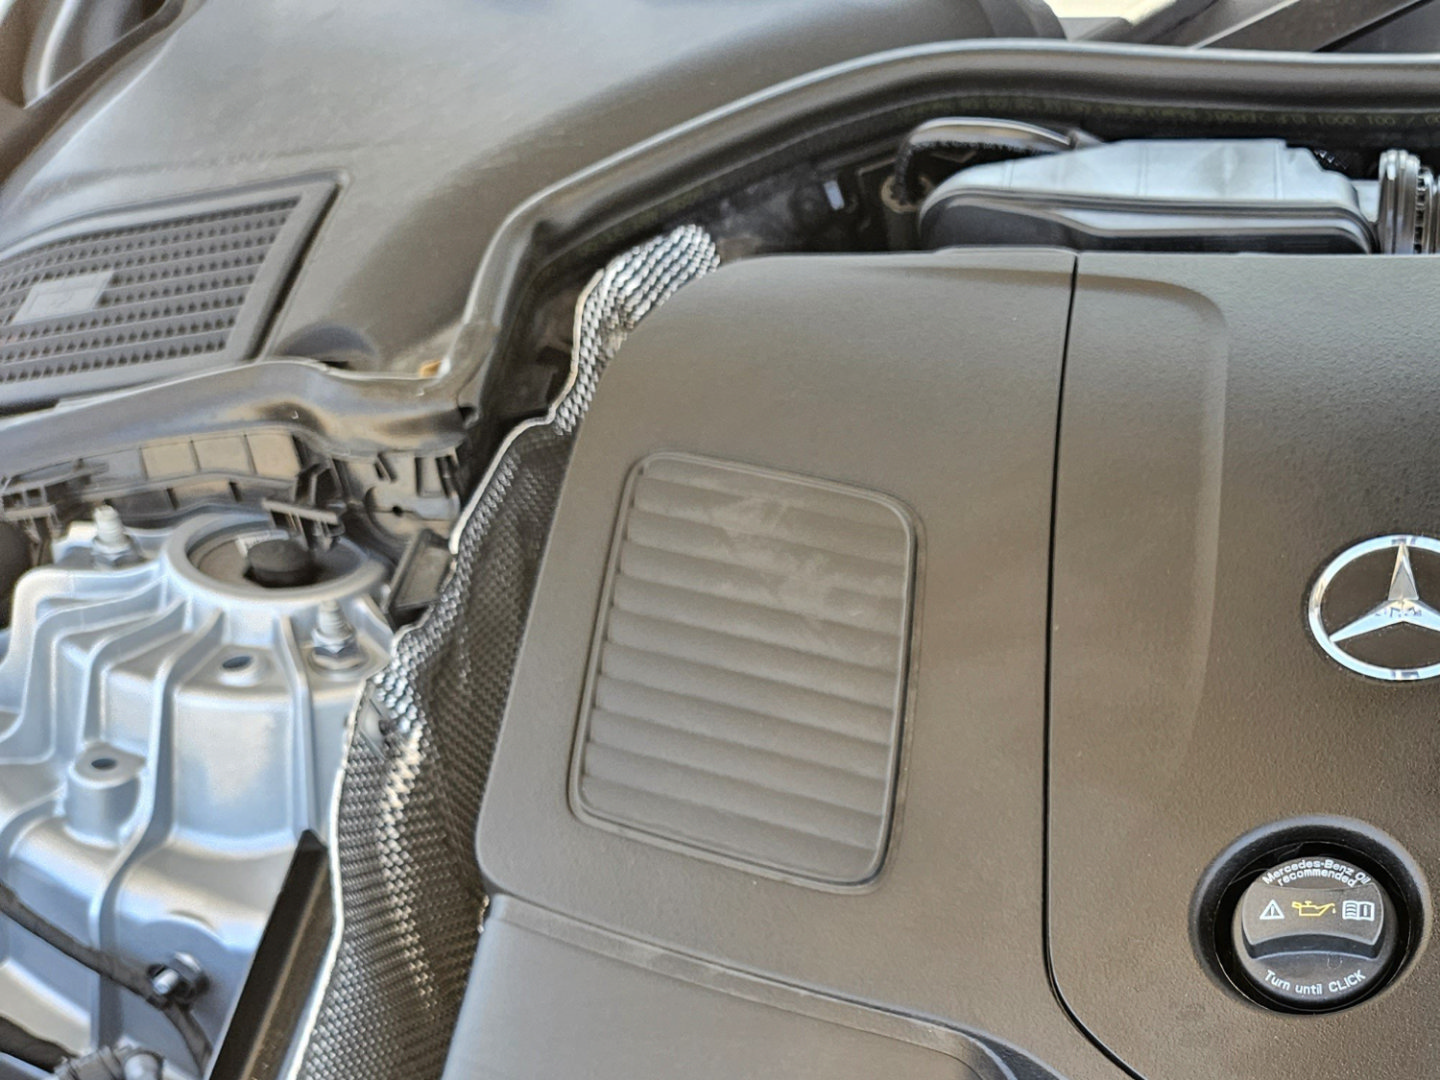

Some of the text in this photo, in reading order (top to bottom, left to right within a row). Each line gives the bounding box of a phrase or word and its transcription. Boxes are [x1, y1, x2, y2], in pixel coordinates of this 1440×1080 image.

[1262, 859, 1371, 885] Mercedes-Benz Oil
[1278, 868, 1357, 887] recommended
[1264, 969, 1366, 995] Turn until CLICK
